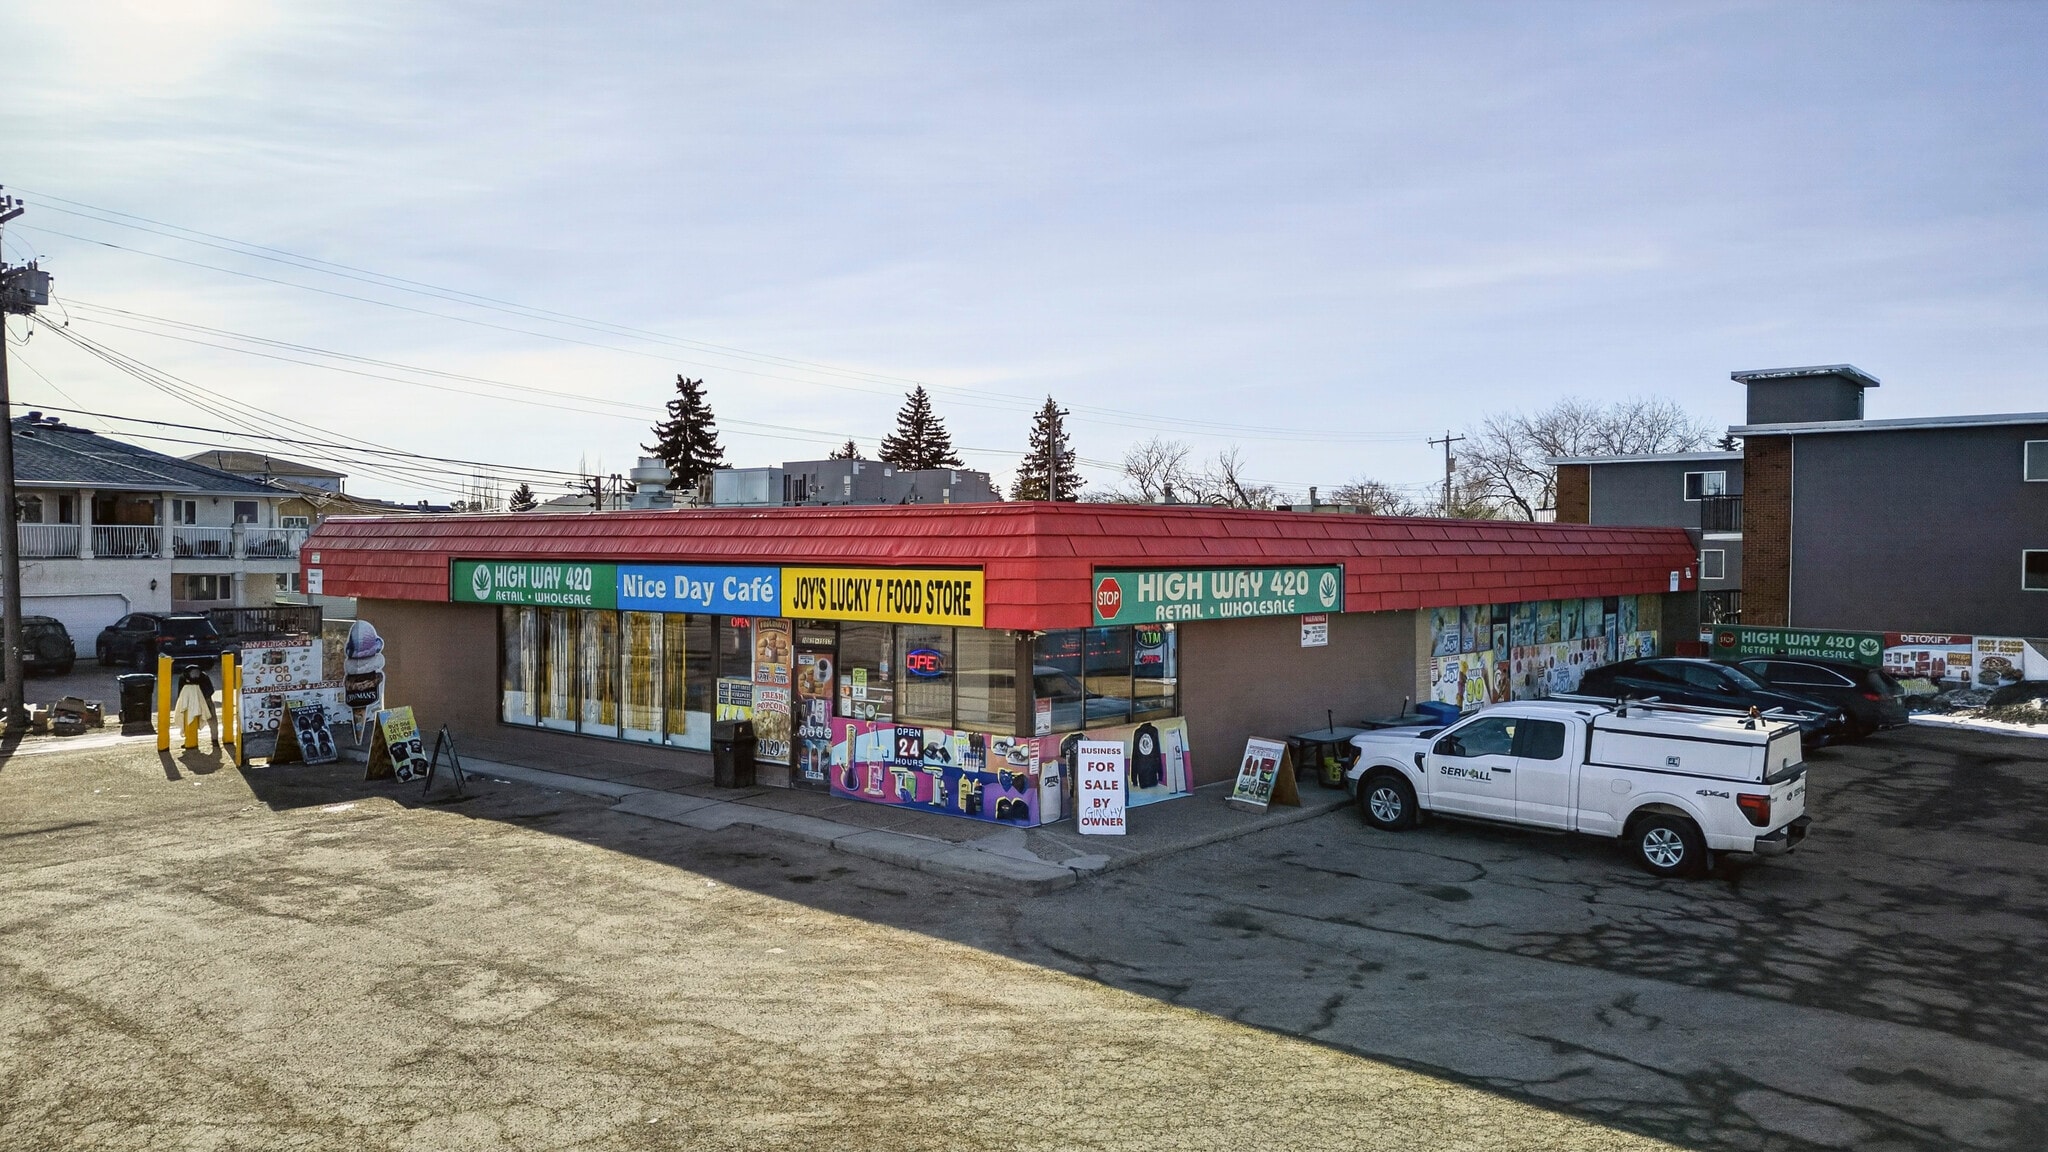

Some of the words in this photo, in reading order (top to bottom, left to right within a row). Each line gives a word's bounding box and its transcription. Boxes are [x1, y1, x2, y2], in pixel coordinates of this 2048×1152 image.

[495, 566, 526, 588] HIGH
[531, 567, 561, 589] WAY
[565, 567, 592, 591] 420
[623, 574, 666, 598] Nice
[675, 576, 715, 607] Day
[723, 575, 773, 602] Café
[1138, 572, 1202, 602] HIGH
[1212, 571, 1263, 599] WAY
[1270, 570, 1309, 596] 420
[496, 591, 524, 602] RETAIL
[535, 593, 592, 605] WHOLESALE
[793, 577, 826, 611] JOY'S
[830, 578, 872, 612] LUCKY
[876, 579, 883, 612] 7
[887, 579, 922, 614] FOOD
[926, 580, 971, 616] STORE
[1098, 591, 1119, 606] STOP
[1156, 604, 1203, 620] RETAIL
[1220, 599, 1295, 617] WHOLESALE
[731, 616, 749, 628] OPEN
[1141, 632, 1160, 643] ATM
[1720, 636, 1734, 644] STOP
[1741, 631, 1780, 645] HIGH
[1785, 633, 1820, 647] WAY
[1826, 635, 1855, 649] 420
[1900, 634, 1951, 644] DETOXIFY
[1741, 645, 1775, 655] RETAIL
[1788, 648, 1855, 660] WHOLESALE
[907, 655, 946, 671] OPEN
[269, 666, 289, 674] FOR
[761, 691, 784, 700] FRESH
[757, 700, 790, 714] POPCORN
[268, 709, 282, 717] FO
[897, 727, 921, 737] OPEN
[899, 738, 919, 757] 24
[1081, 747, 1121, 755] BUSINESS
[895, 758, 923, 767] HOURS
[1088, 762, 1115, 772] FOR
[1085, 780, 1118, 790] SALE
[1093, 798, 1110, 808] BY
[1081, 817, 1123, 826] OWNER
